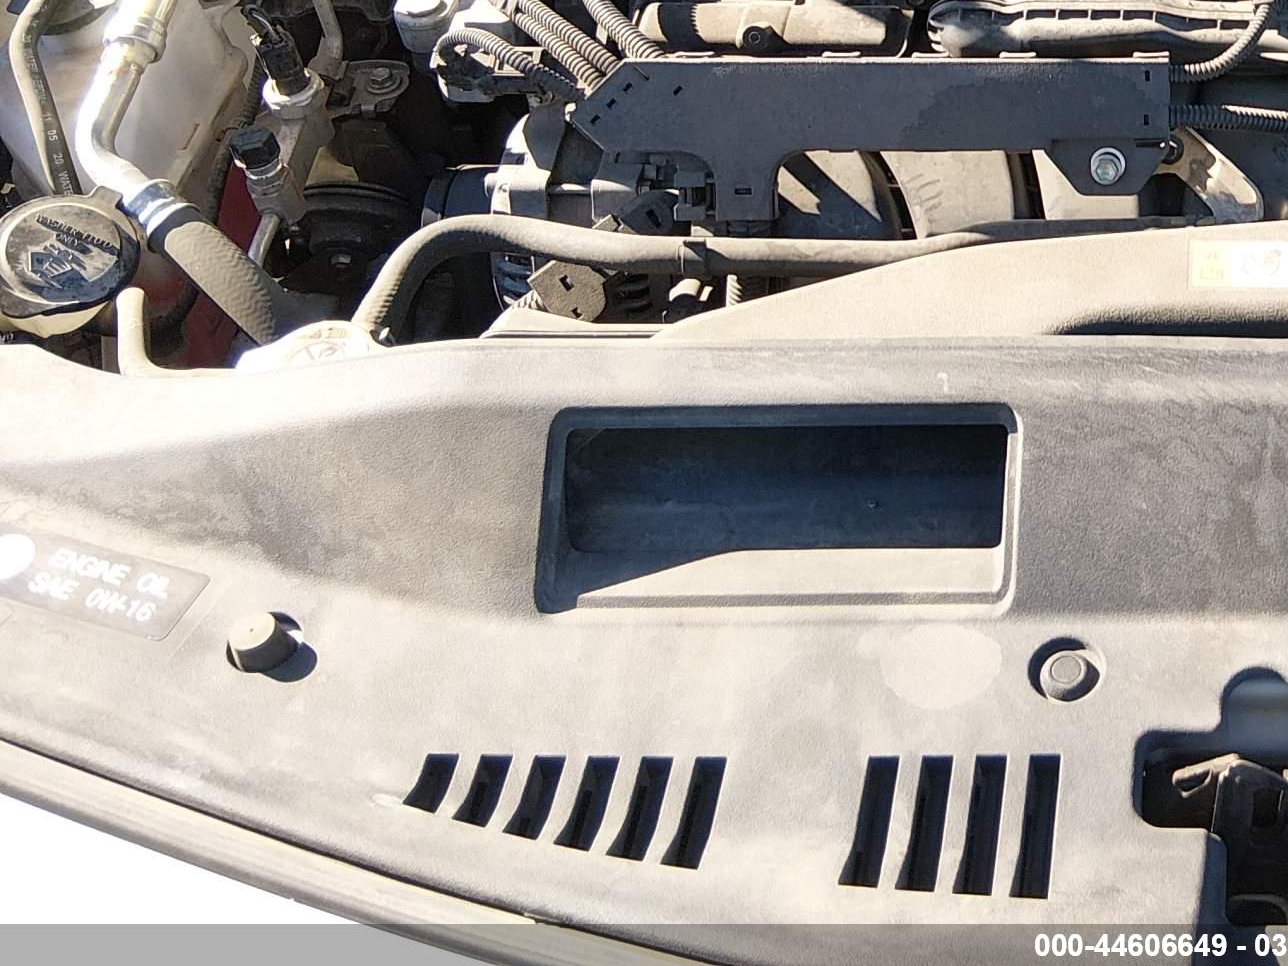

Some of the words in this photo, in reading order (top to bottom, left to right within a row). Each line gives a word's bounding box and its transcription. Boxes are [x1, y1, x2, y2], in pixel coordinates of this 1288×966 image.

[47, 129, 59, 141] 05
[53, 153, 64, 165] 20
[49, 547, 131, 586] ENGINE
[28, 572, 80, 601] SAE
[85, 588, 157, 622] 0W-16
